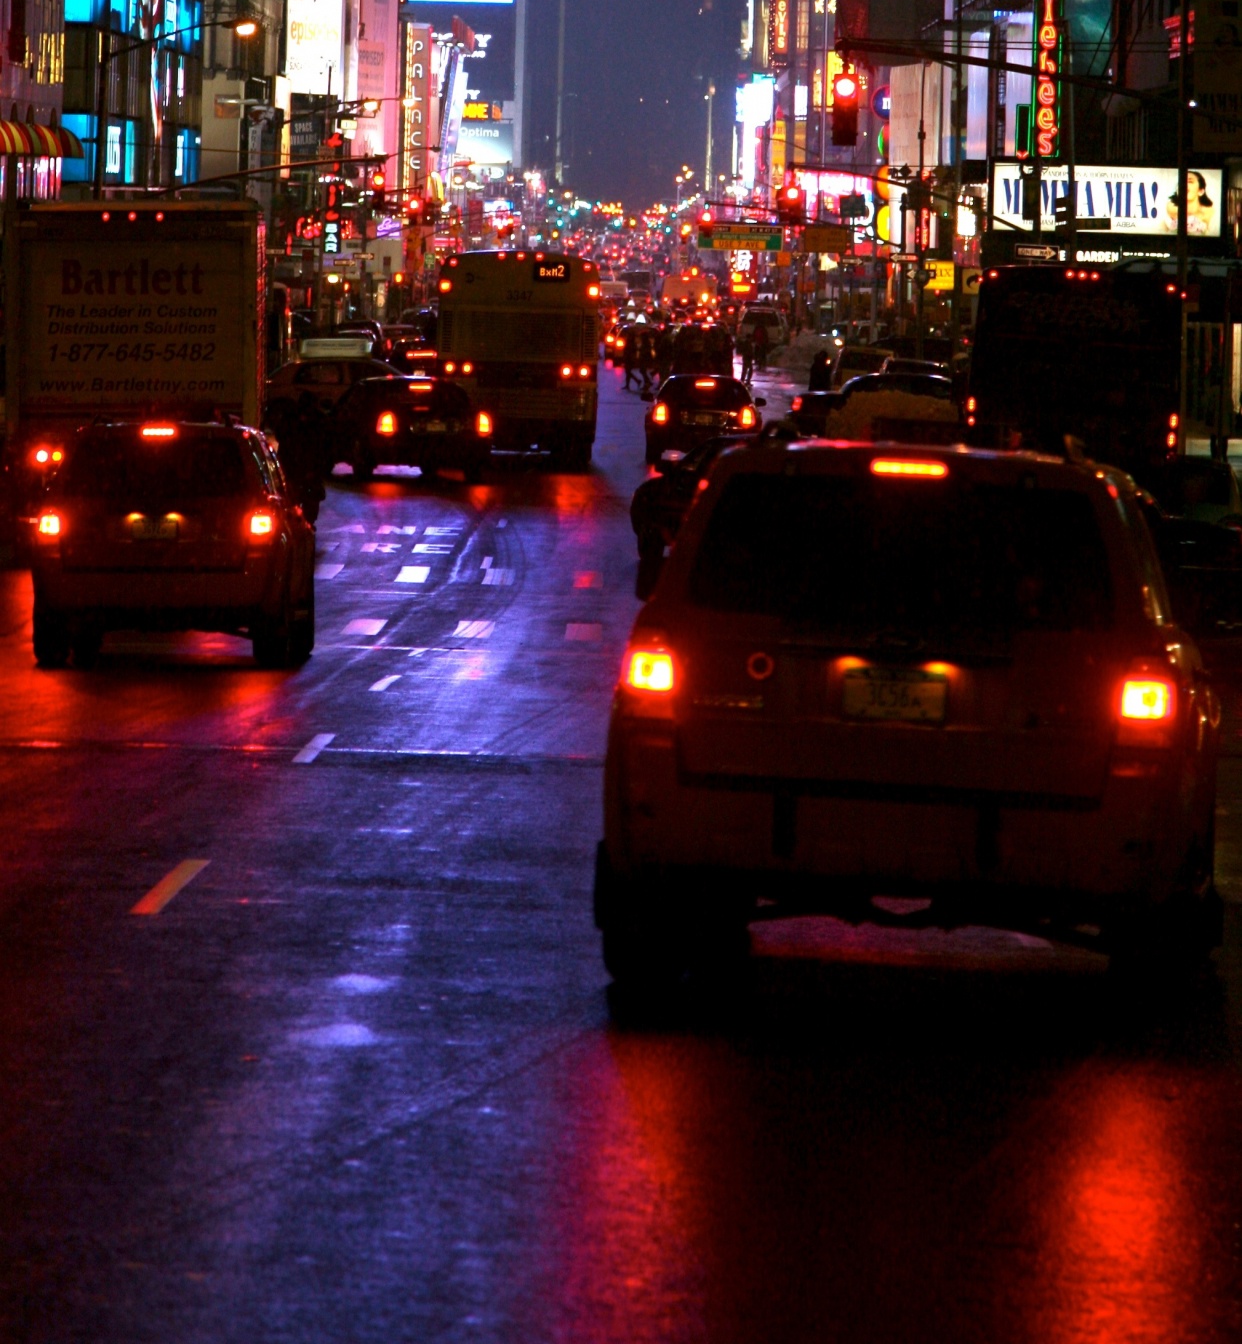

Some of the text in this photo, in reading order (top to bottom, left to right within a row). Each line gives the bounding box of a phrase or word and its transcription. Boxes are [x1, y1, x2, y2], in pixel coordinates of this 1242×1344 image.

[459, 127, 500, 138] Optima
[1104, 180, 1159, 219] MIA!
[324, 223, 338, 253] BAR
[1040, 249, 1053, 257] WAY
[1076, 250, 1119, 262] GARDEN
[61, 259, 204, 295] Bartlett
[540, 265, 565, 277] BxM2
[47, 304, 217, 317] The Leader in Custom
[48, 321, 216, 335] Distribution Solutions
[49, 342, 216, 363] 1-877-645-5482
[40, 378, 225, 394] www.Bartlettny.com
